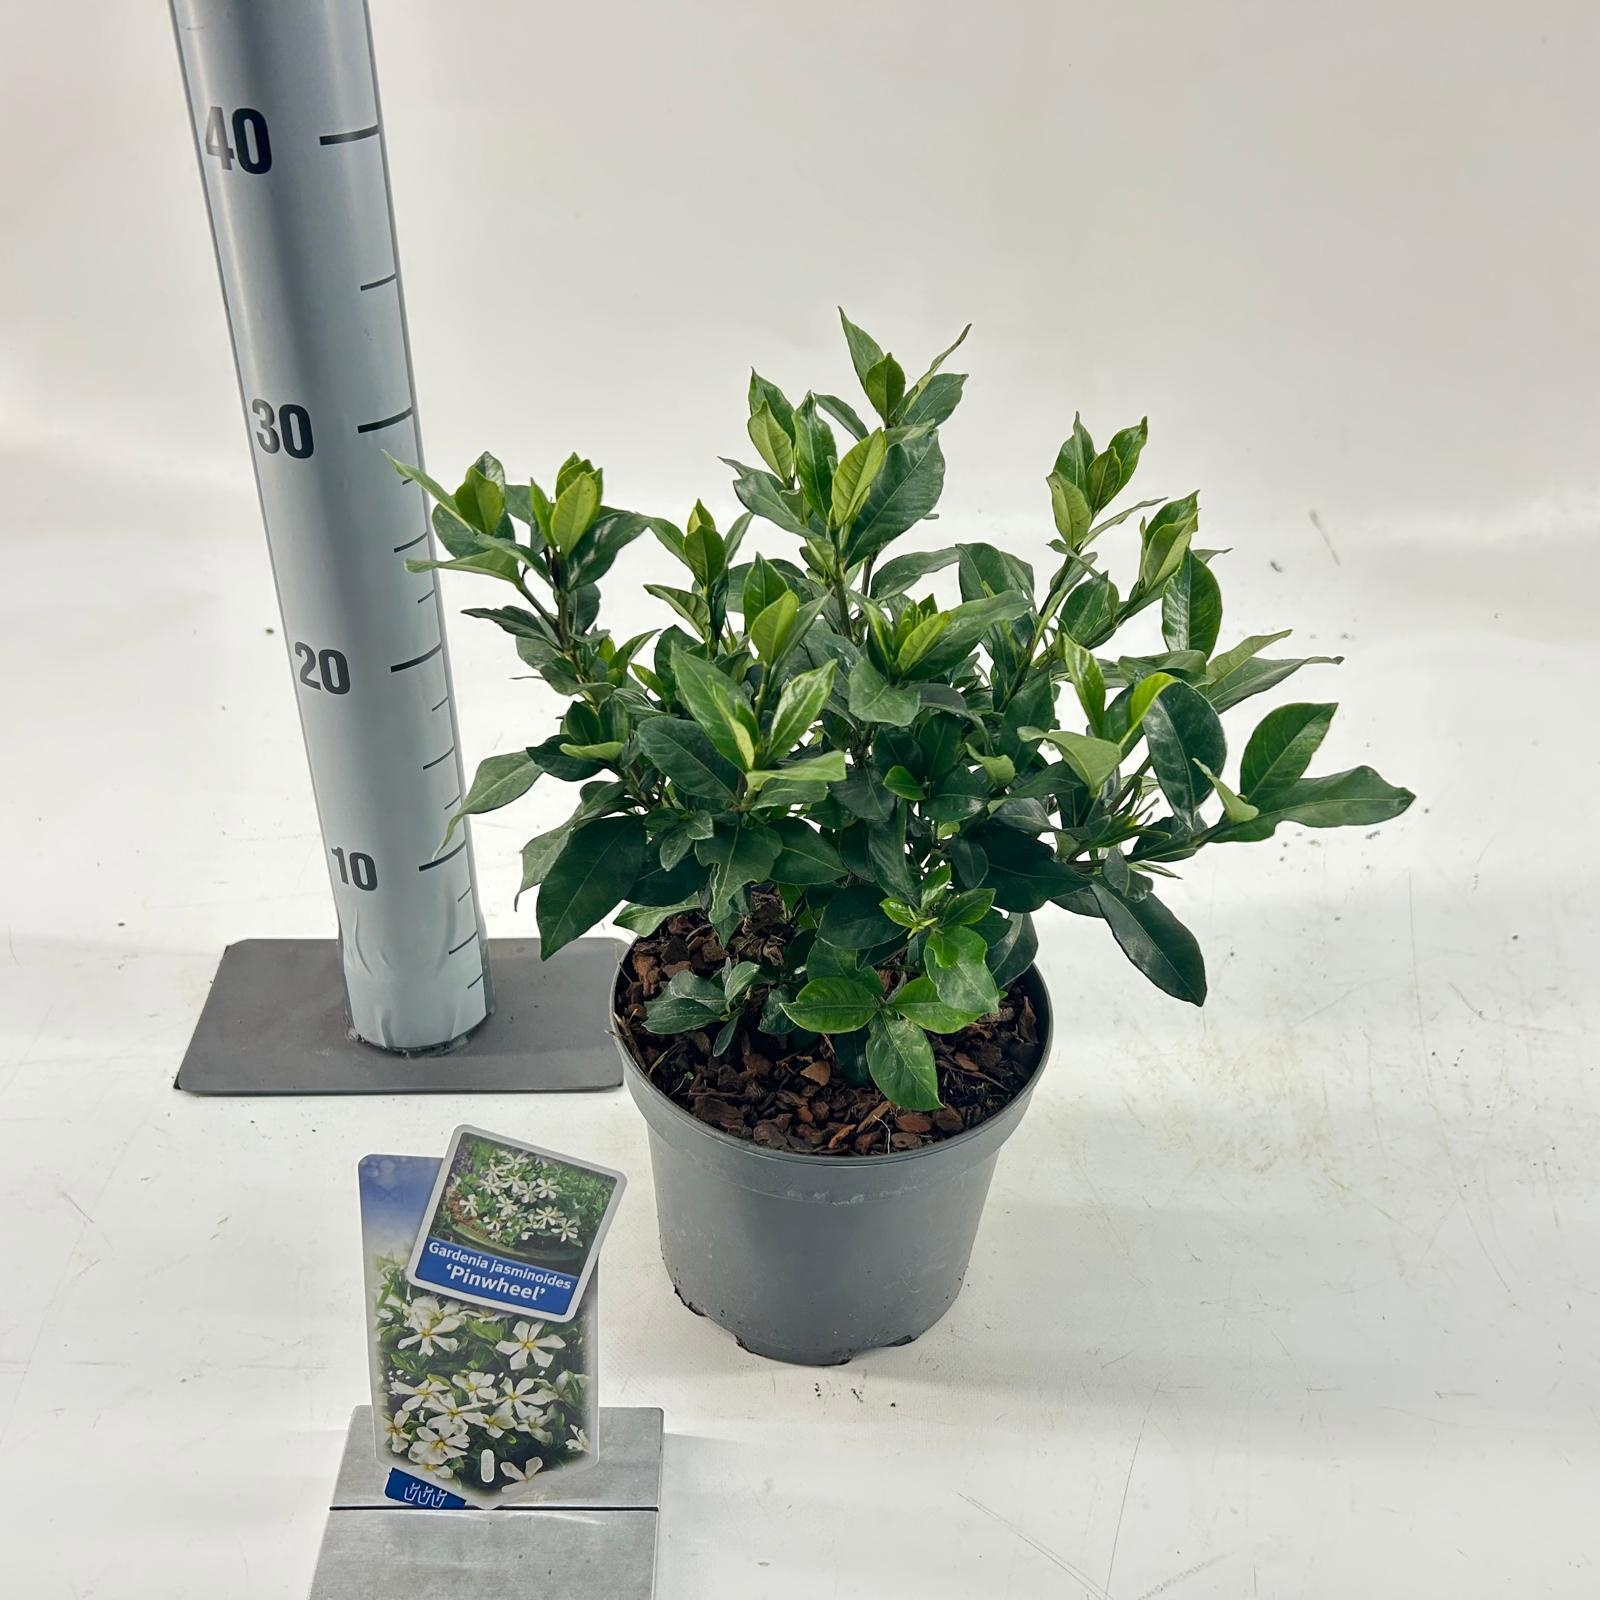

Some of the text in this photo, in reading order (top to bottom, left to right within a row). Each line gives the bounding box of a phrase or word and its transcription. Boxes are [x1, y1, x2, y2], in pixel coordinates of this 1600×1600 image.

[204, 106, 272, 174] 40
[251, 398, 314, 459] 30
[295, 642, 350, 695] 20
[332, 847, 378, 891] 10
[428, 1241, 572, 1289] Gardenia jasminoides
